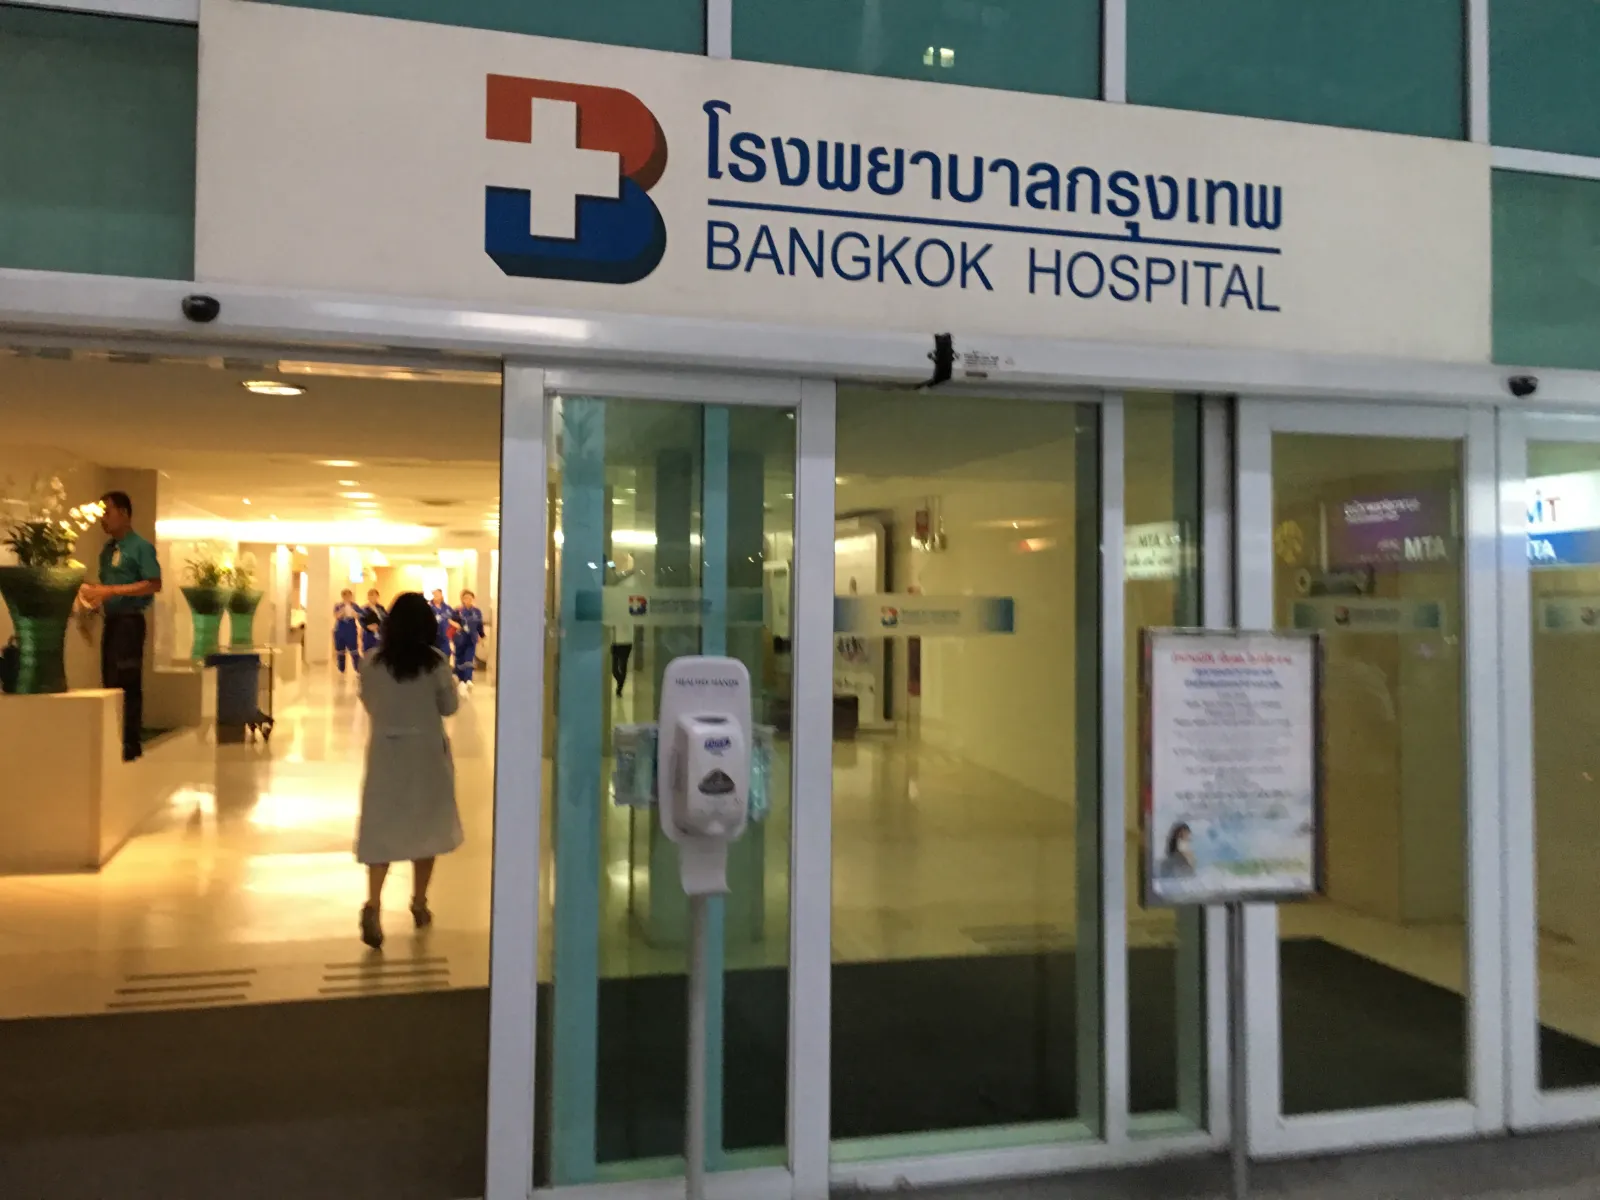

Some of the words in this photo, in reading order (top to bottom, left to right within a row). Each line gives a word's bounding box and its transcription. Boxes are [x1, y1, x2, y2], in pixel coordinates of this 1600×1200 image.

[702, 99, 1282, 238] โรงพยาบาลกรุงเทพ
[706, 219, 993, 291] BANGKOK
[1028, 247, 1281, 312] HOSPITAL
